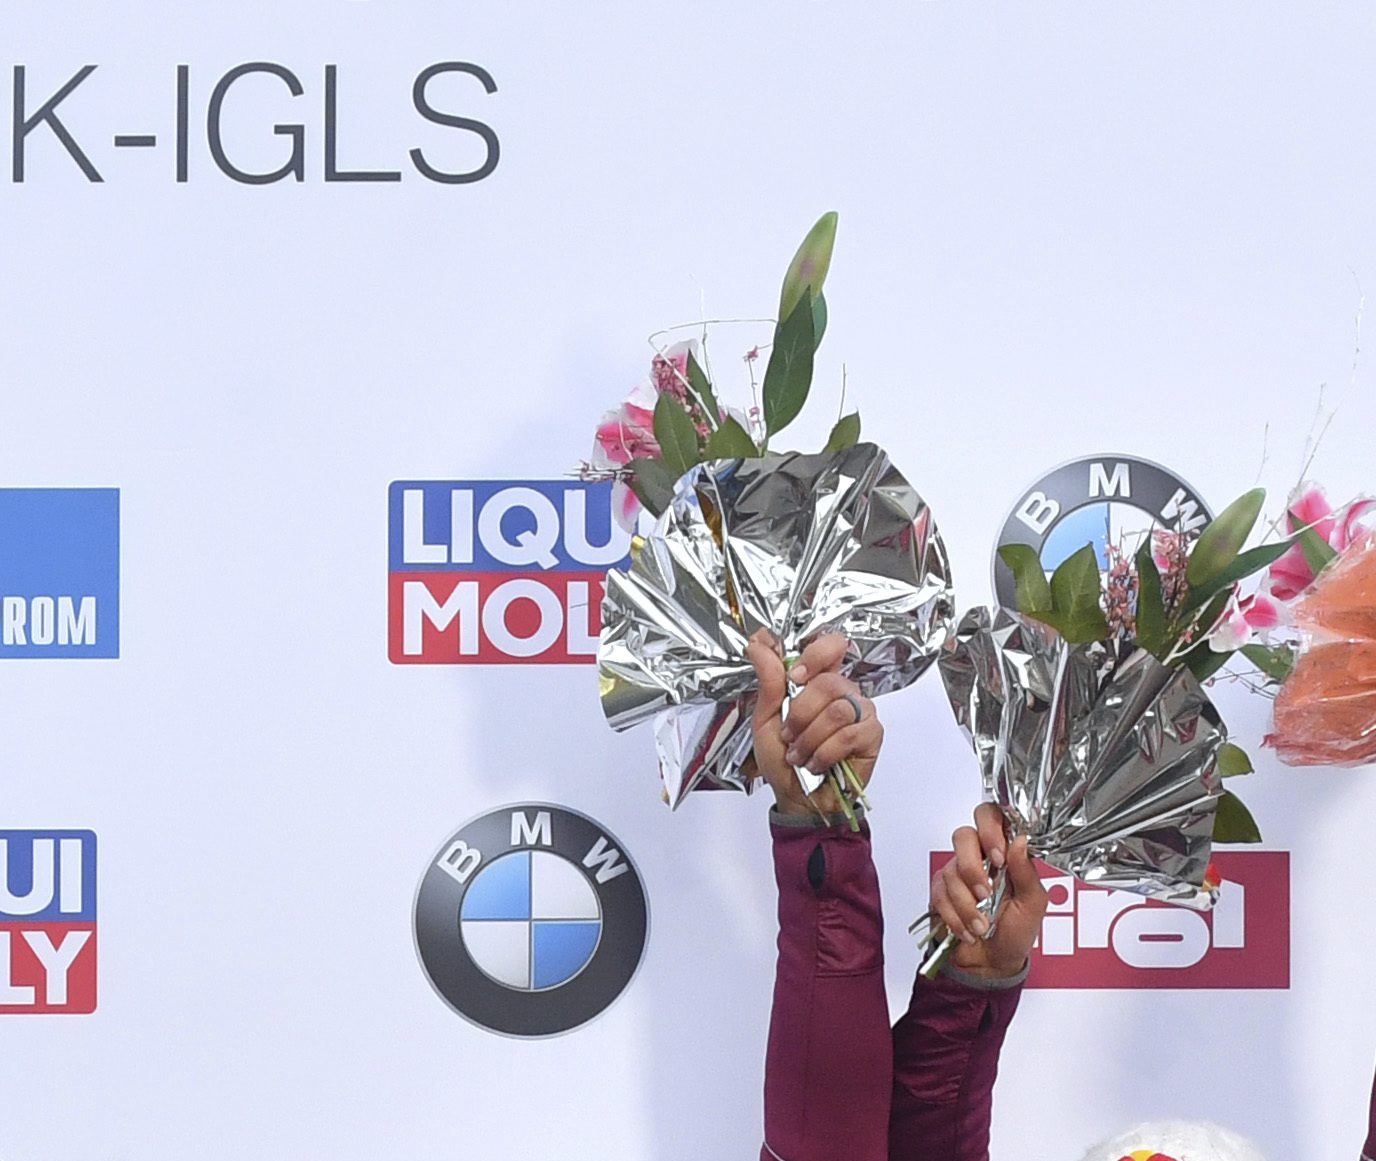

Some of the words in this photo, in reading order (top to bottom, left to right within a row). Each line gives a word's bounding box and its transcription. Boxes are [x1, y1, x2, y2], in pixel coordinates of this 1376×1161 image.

[1015, 463, 1208, 536] BMW
[403, 578, 607, 657] MOL
[435, 811, 631, 887] BMW
[1030, 875, 1246, 969] irol
